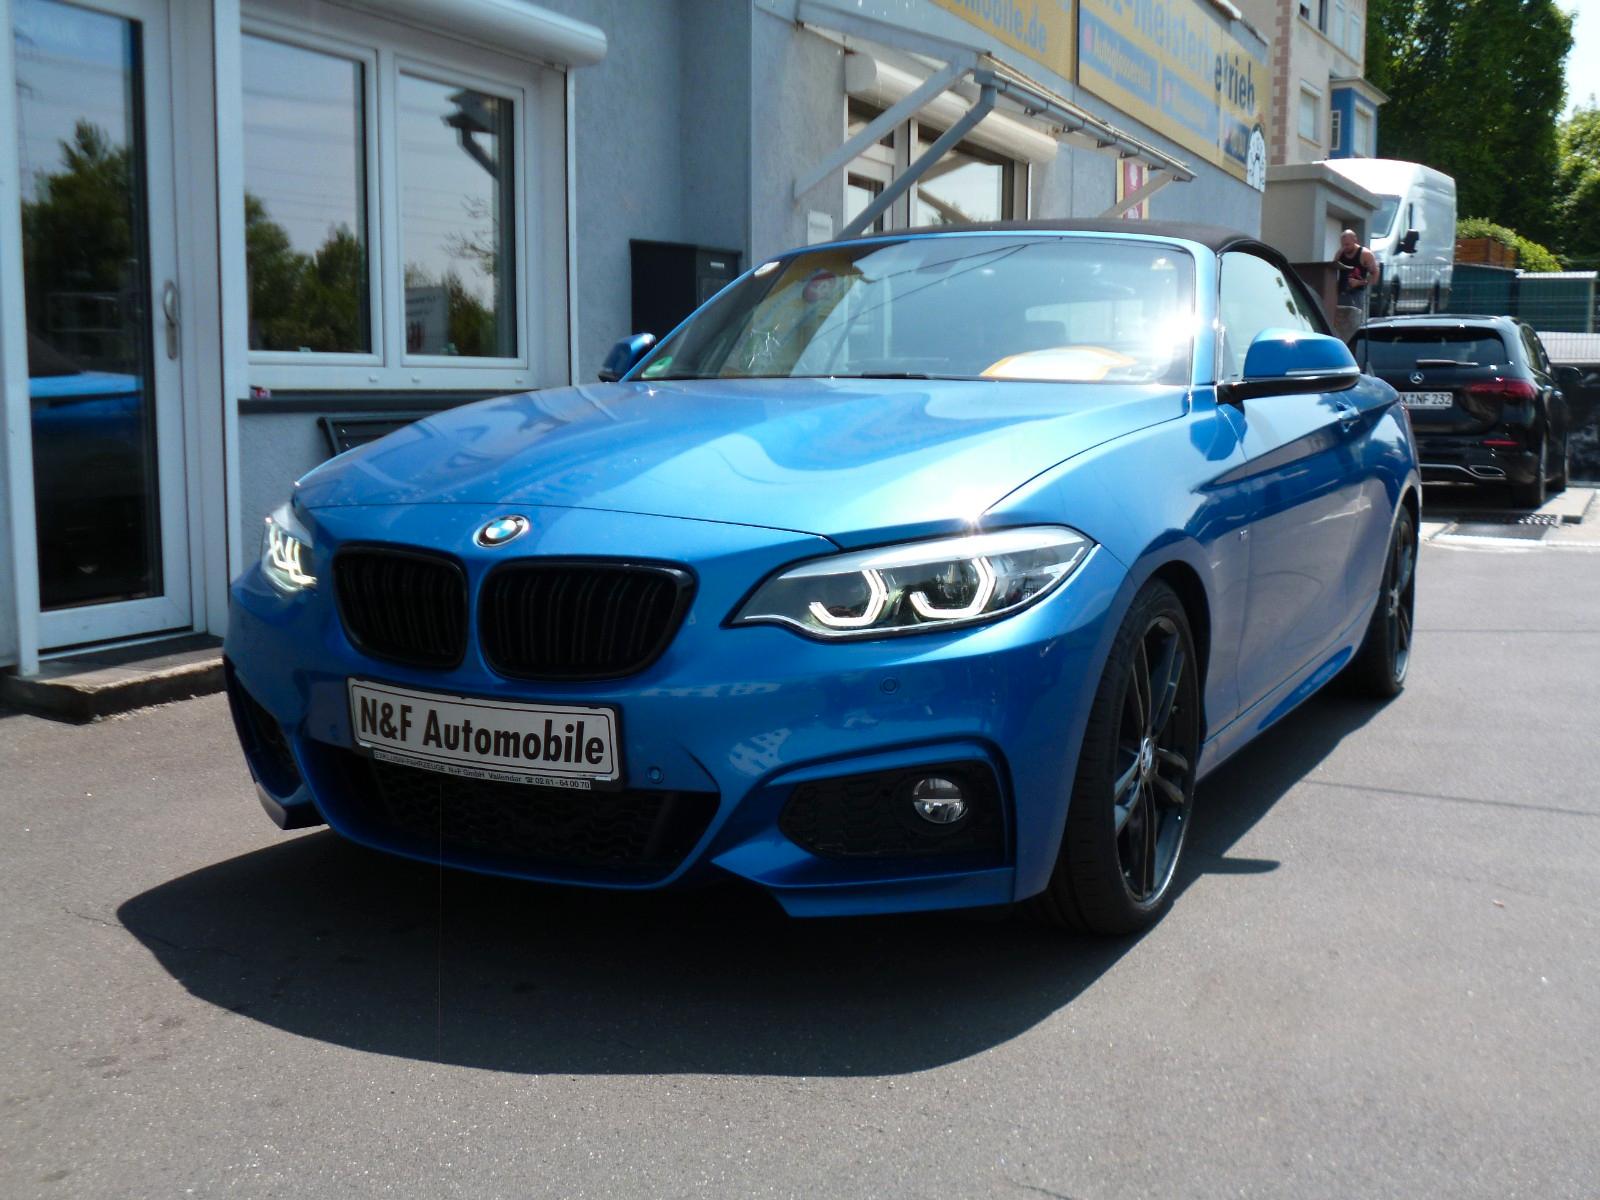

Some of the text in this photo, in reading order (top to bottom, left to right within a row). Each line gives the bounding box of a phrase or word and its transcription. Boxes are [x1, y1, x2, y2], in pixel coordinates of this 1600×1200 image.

[1416, 393, 1429, 404] NF
[1432, 393, 1452, 405] 232
[360, 695, 605, 764] N&F Automobile
